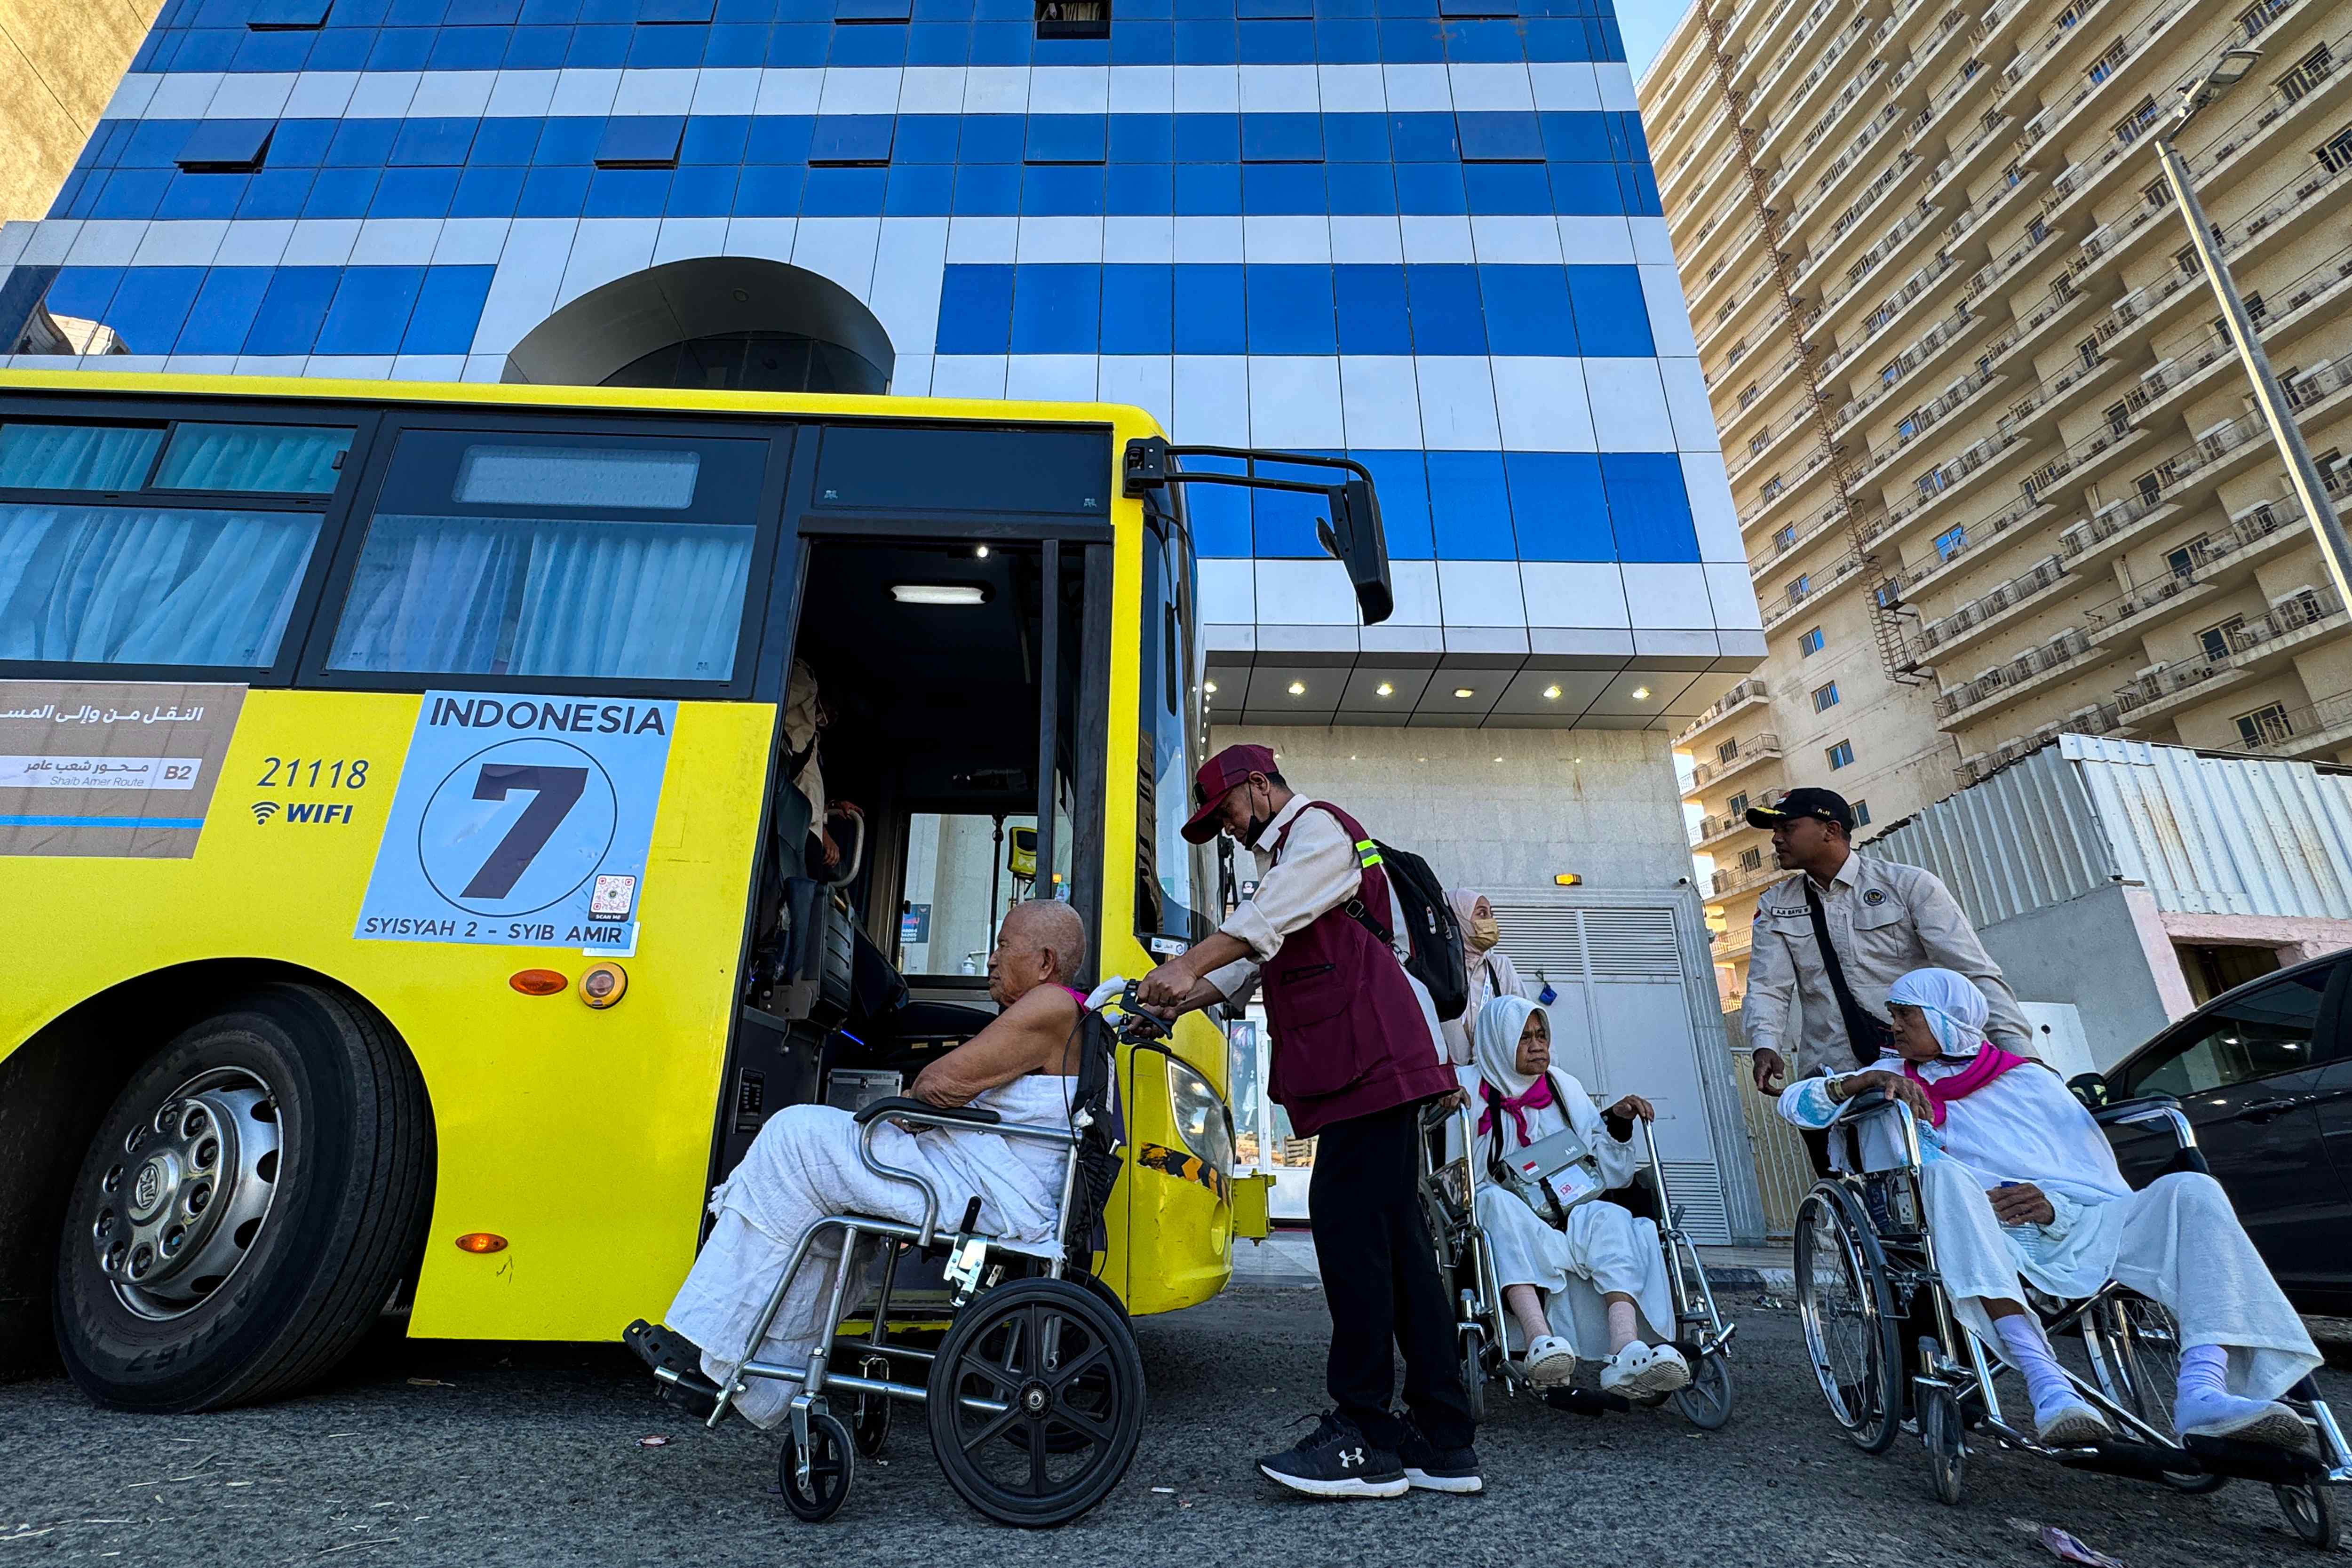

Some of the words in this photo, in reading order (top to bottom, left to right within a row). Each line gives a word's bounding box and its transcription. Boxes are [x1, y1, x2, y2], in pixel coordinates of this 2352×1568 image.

[0, 705, 55, 719] المس
[55, 706, 100, 724] وإلى
[103, 709, 140, 723] من
[143, 707, 204, 724] النقل
[430, 698, 665, 736] INDONESIA
[24, 760, 53, 773] عامر
[56, 760, 92, 774] شعب
[92, 764, 149, 774] محور
[164, 766, 192, 780] B2
[257, 757, 369, 789] 21118
[82, 777, 112, 786] Amer
[113, 778, 144, 787] Route
[287, 804, 354, 824] WIFI
[459, 763, 589, 899] 7
[364, 917, 456, 936] SYISYAH
[464, 922, 478, 937] 2
[508, 923, 555, 940] SYIB
[565, 925, 622, 943] AMIR
[1565, 1146, 1578, 1156] AMI
